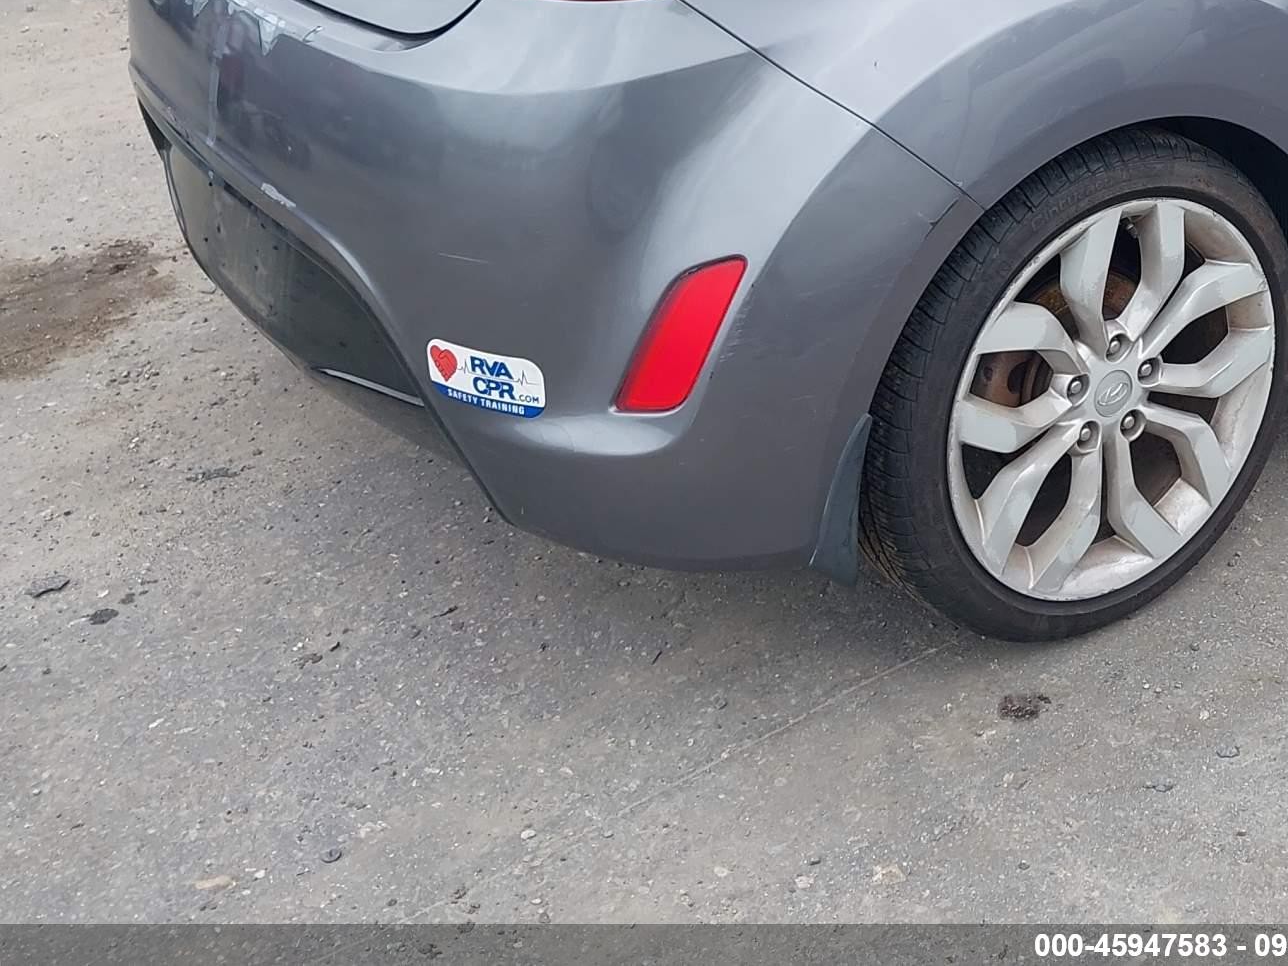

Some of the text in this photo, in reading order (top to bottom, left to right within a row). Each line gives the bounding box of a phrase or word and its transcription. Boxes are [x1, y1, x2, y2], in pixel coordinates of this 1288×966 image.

[470, 355, 514, 380] RVA
[448, 388, 525, 415] SAFETY TRAINING
